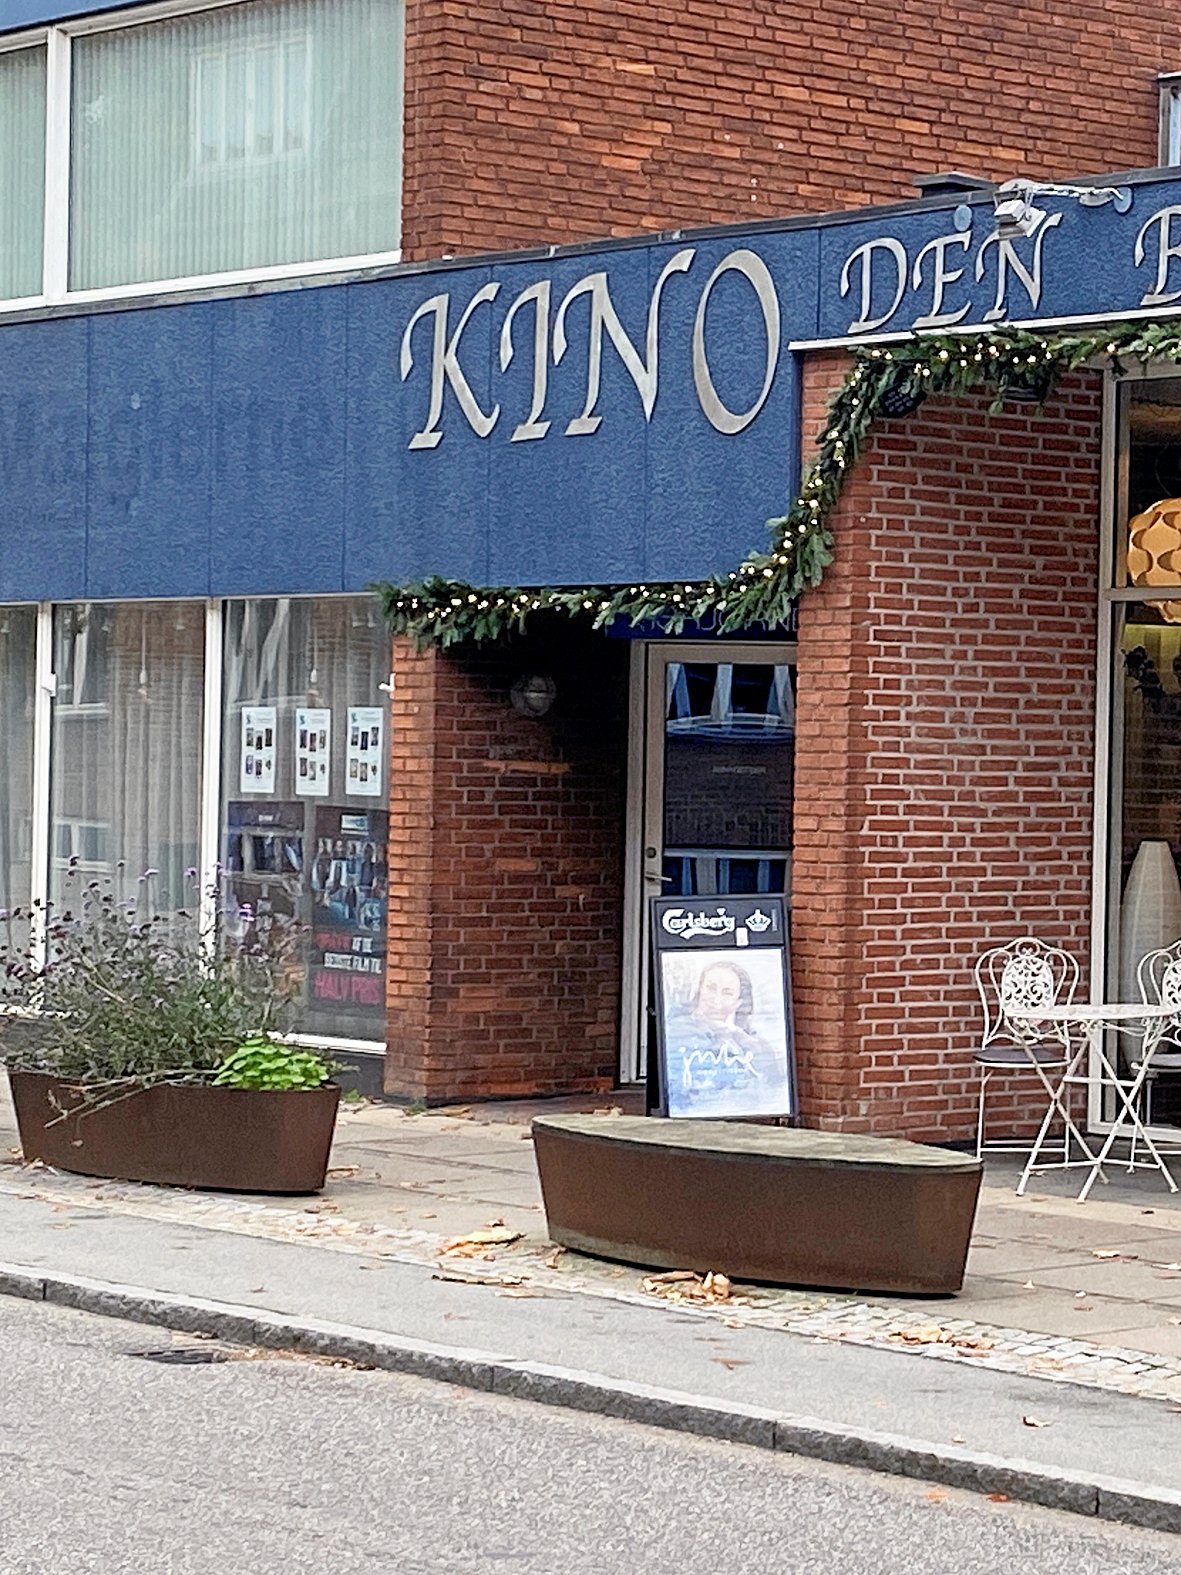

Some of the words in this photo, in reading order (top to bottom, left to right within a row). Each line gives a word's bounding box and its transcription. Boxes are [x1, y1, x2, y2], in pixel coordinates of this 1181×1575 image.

[840, 212, 1063, 334] DEN
[401, 248, 782, 450] KINO
[662, 907, 736, 940] Carlsberg
